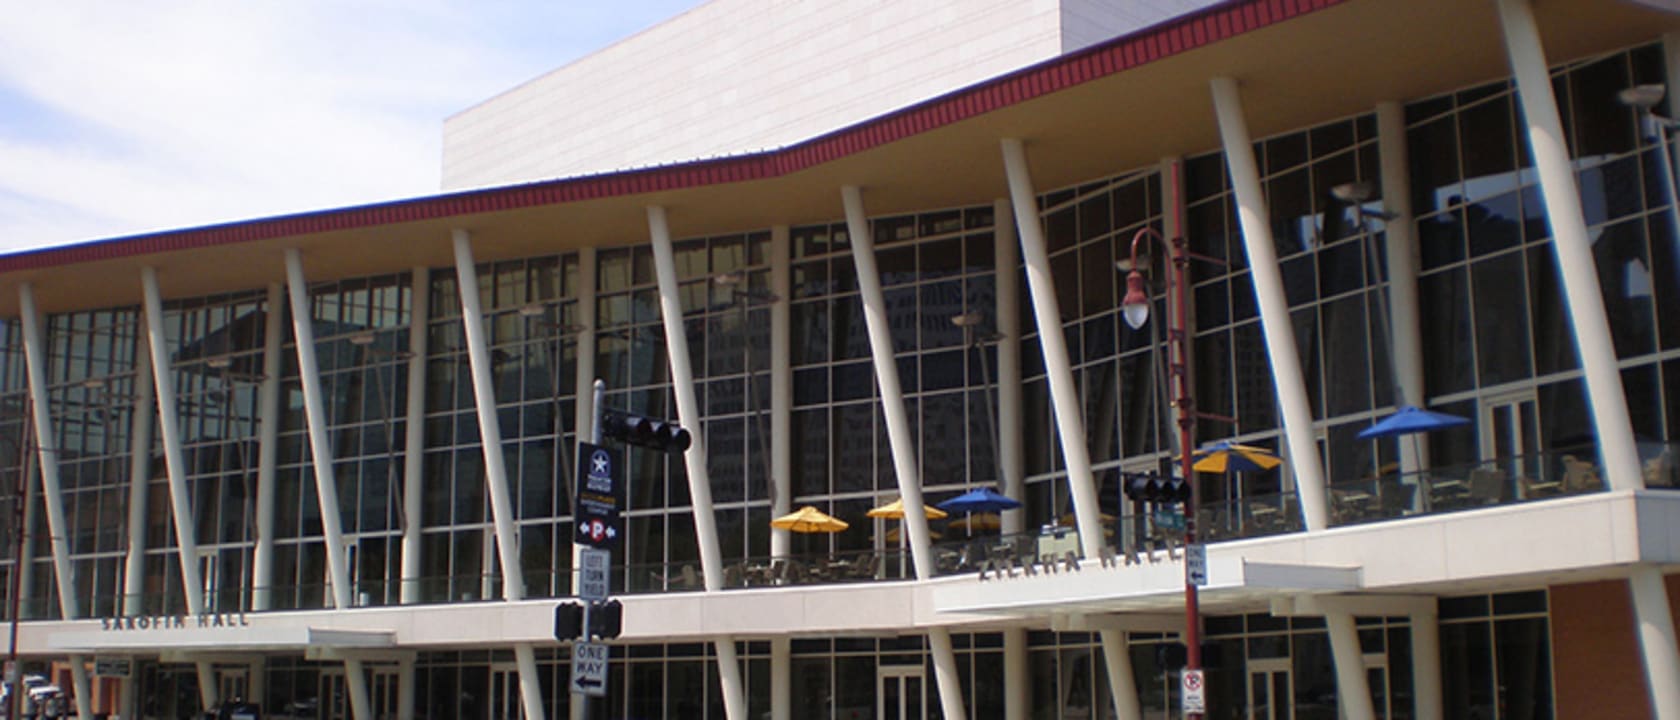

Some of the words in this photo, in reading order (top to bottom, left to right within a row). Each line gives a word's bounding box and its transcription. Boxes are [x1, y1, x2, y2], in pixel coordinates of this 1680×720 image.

[592, 521, 604, 538] P
[976, 551, 1080, 581] ZILKHA
[1100, 538, 1182, 568] HALL
[585, 569, 604, 581] TURN
[198, 612, 249, 627] HALL
[578, 645, 602, 660] ONE
[577, 661, 602, 674] WAY
